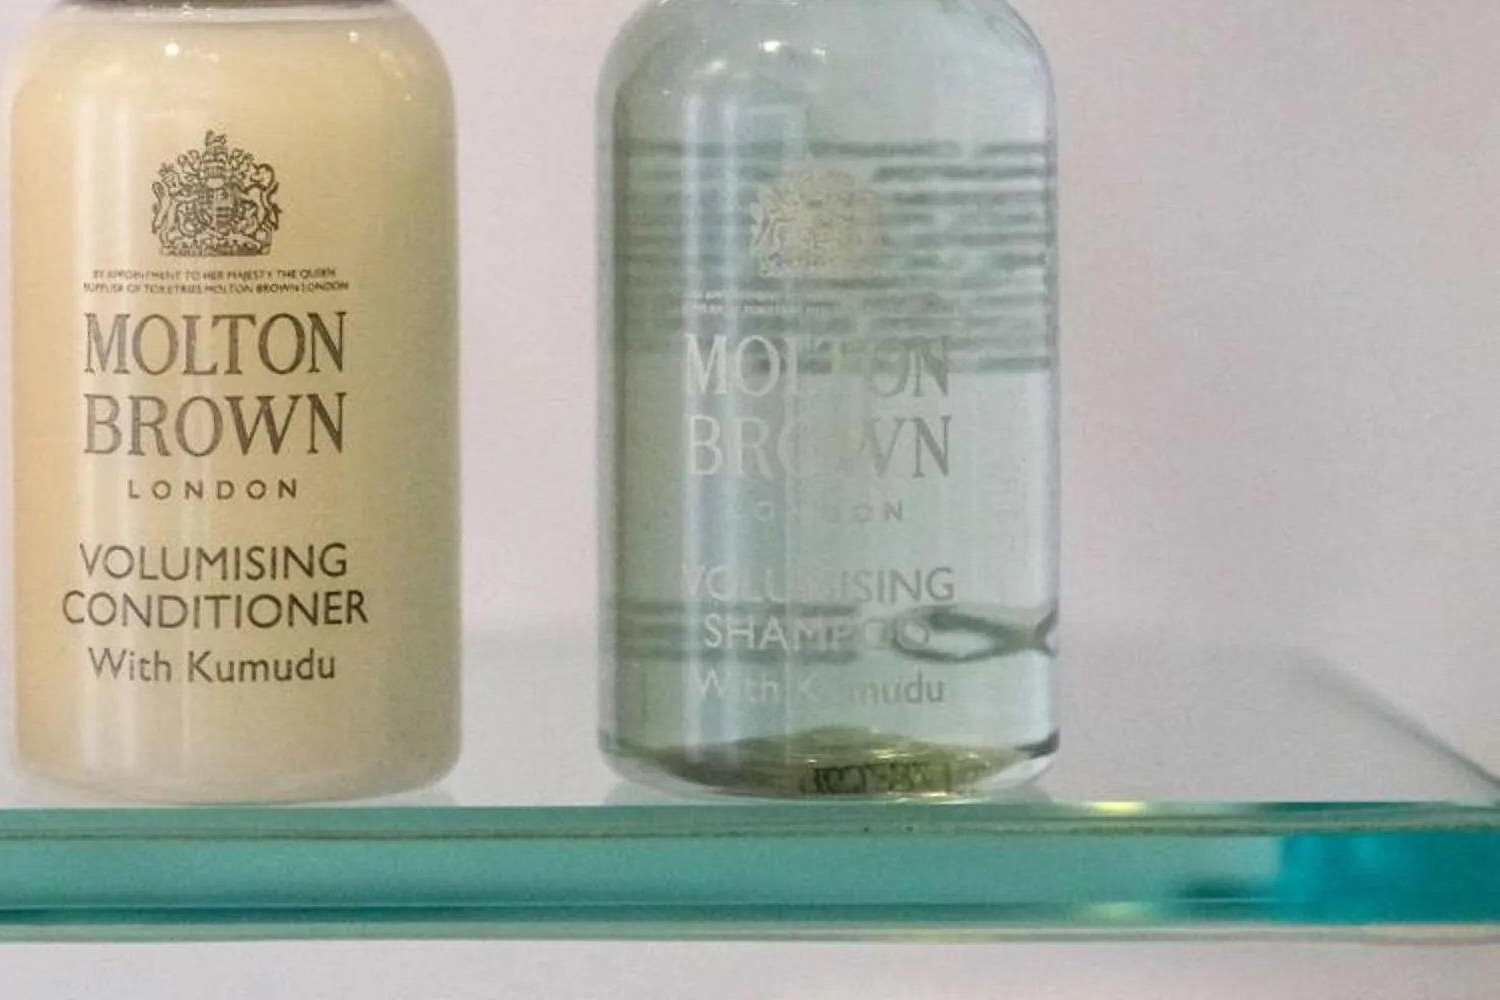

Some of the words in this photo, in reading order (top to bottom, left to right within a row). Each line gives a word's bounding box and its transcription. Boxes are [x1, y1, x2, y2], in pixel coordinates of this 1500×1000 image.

[83, 311, 348, 376] MOLTON
[83, 392, 348, 457] BROWN
[128, 477, 298, 500] LONDON
[79, 541, 348, 582] VOLUMISING
[61, 589, 370, 629] CONDITIONER
[87, 646, 173, 683] With
[187, 647, 337, 684] Kumudu
